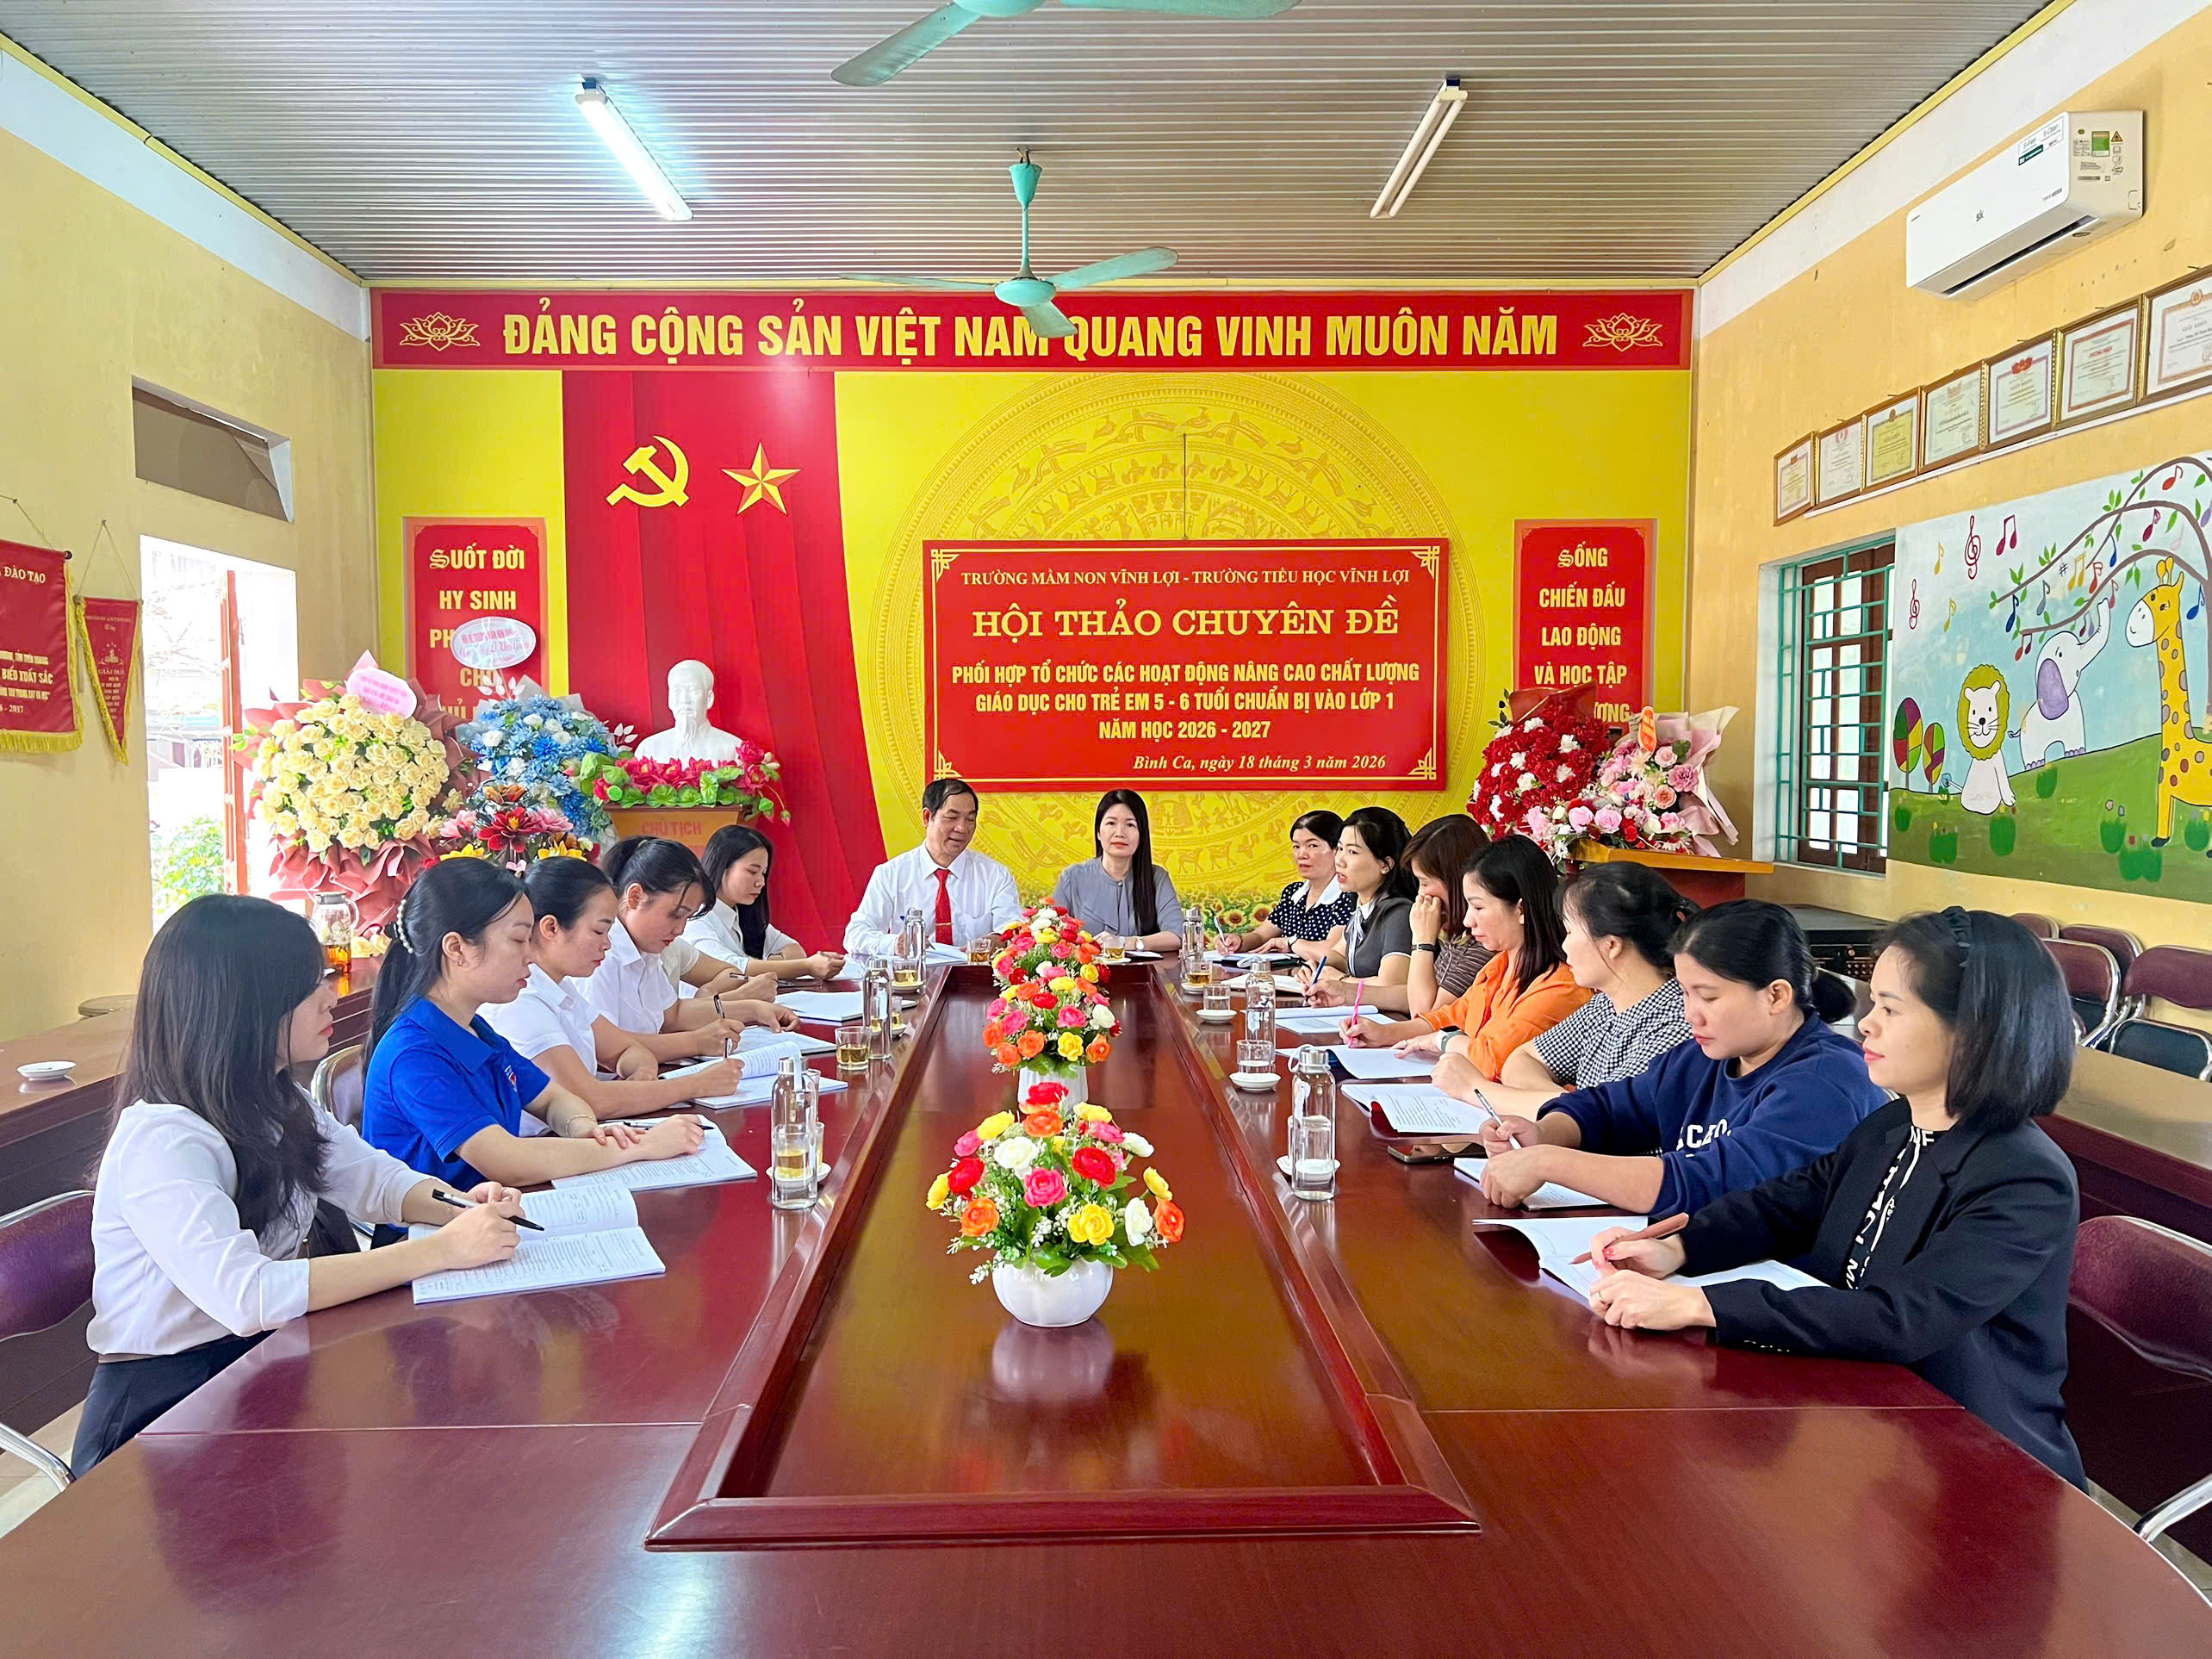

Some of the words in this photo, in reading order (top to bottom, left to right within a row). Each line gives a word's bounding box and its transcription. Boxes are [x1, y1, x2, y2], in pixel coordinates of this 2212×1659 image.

[502, 296, 618, 356] ĐẢNG
[631, 306, 744, 364] CỘNG
[757, 297, 842, 357] SẢN
[854, 307, 942, 365] VIỆT
[954, 316, 1049, 357] NAM
[1063, 315, 1202, 362] QUANG
[1215, 315, 1312, 357] VINH
[1325, 307, 1449, 357] MUÔN
[1463, 306, 1558, 356] NĂM
[429, 542, 488, 569] SUỐT
[492, 544, 525, 569] ĐỜI
[1557, 540, 1609, 568] SỐNG
[960, 569, 1028, 586] TRƯỜNG
[1074, 571, 1107, 585] NON
[1110, 569, 1149, 584] VĨNH
[1153, 570, 1180, 587] LỢI
[1191, 567, 1258, 584] TRƯỜNG
[1302, 570, 1336, 587] HỌC
[1339, 567, 1378, 583] VĨNH
[1382, 569, 1410, 586] LỢI
[439, 590, 464, 610] HY
[469, 590, 517, 611] SINH
[1538, 581, 1588, 608] CHIẾN
[1592, 581, 1626, 607] ĐẤU
[972, 602, 1043, 643] HỘI
[1054, 598, 1162, 637] THẢO
[1172, 600, 1334, 636] CHUYÊN
[1345, 594, 1399, 635] ĐỀ
[1541, 626, 1573, 647] LAO
[1576, 622, 1622, 650] ĐỘNG
[952, 660, 990, 684] PHỐI
[994, 664, 1027, 687] HỢP
[1031, 659, 1052, 683] TỔ
[1055, 660, 1098, 683] CHỨC
[1103, 662, 1135, 683] CÁC
[1140, 664, 1181, 687] HOẠT
[1184, 661, 1229, 687] ĐỘNG
[1233, 660, 1279, 682] NÂNG
[1283, 663, 1316, 682] CAO
[1320, 657, 1363, 681] CHẤT
[1366, 662, 1420, 686] LƯỢNG
[1533, 661, 1556, 685] VÀ
[1559, 665, 1593, 688] HỌC
[1596, 661, 1628, 689] TẬP
[975, 690, 1014, 712] GIÁO
[1017, 693, 1050, 716] DỤC
[1054, 693, 1087, 711] CHO
[1090, 686, 1121, 711] TRẺ
[1125, 693, 1150, 711] EM
[1153, 693, 1165, 711] 5
[1179, 693, 1190, 711] 6
[1193, 686, 1230, 711] TUỔI
[1234, 685, 1289, 711] CHUẨN
[1293, 692, 1310, 714] BỊ
[1314, 688, 1346, 710] VÀO
[1350, 687, 1382, 710] LỚP
[1385, 692, 1394, 710] 1
[1099, 718, 1137, 739] NĂM
[1140, 721, 1173, 743] HỌC
[1177, 721, 1217, 739] 2026
[1232, 720, 1271, 738] 2027
[1133, 755, 1168, 769] Bình
[1172, 755, 1196, 771] Ca,
[1199, 755, 1234, 773] ngày
[1238, 755, 1256, 769] 18
[1259, 755, 1300, 773] tháng
[1303, 755, 1313, 769] 3
[1315, 755, 1347, 769] năm
[1351, 755, 1386, 769] 2026
